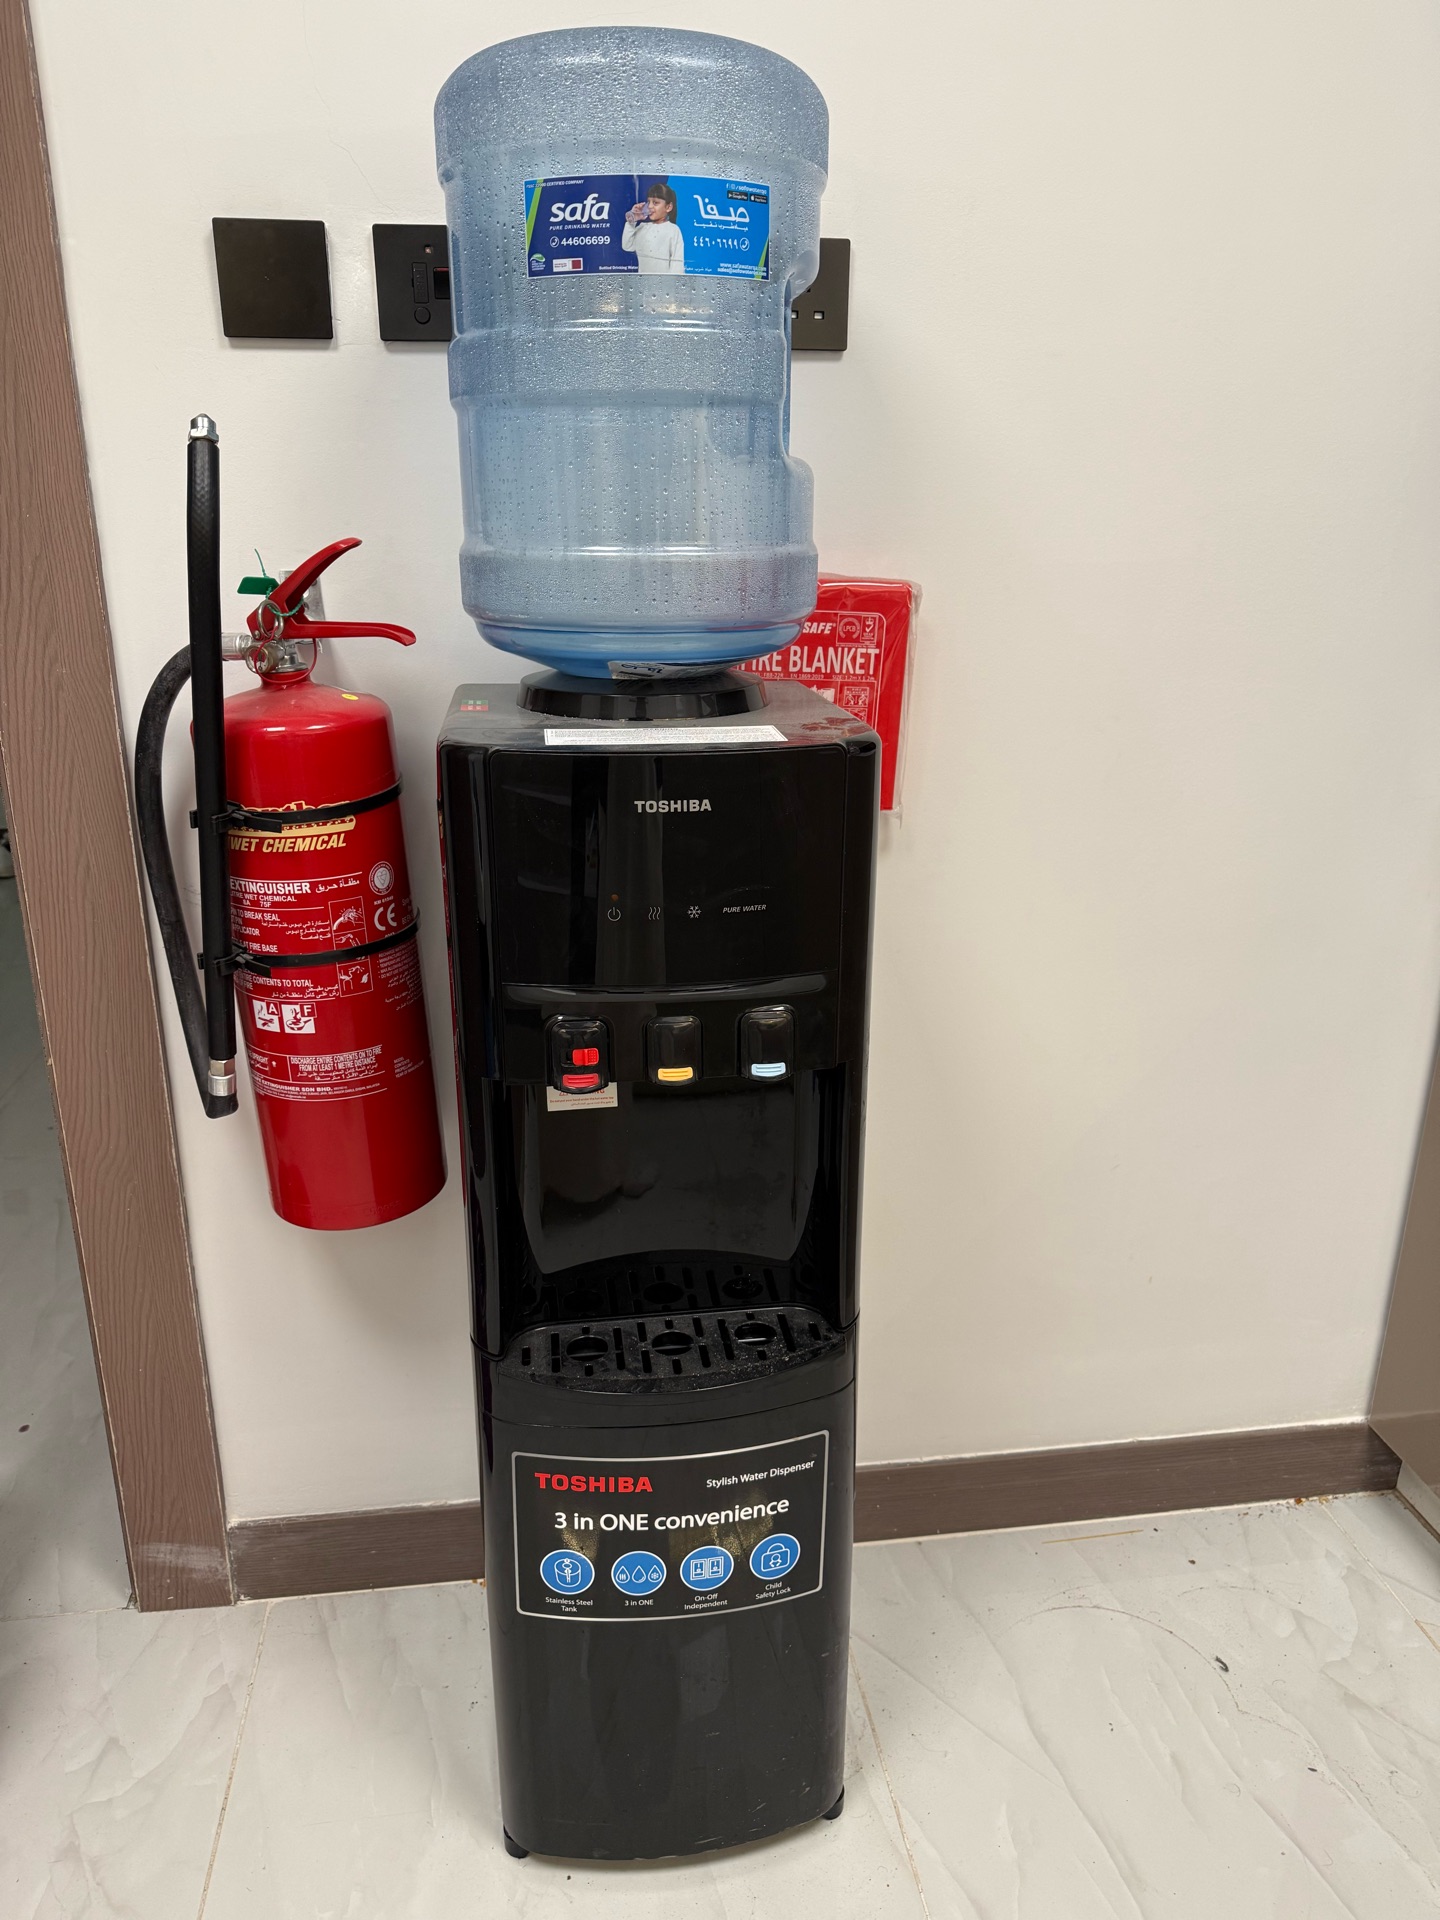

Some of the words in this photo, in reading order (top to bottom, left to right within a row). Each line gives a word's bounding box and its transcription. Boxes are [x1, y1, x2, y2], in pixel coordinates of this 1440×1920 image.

[550, 193, 610, 223] safa
[693, 194, 750, 223] صفا
[561, 236, 610, 246] 44606699
[789, 646, 880, 675] BLANKET
[634, 799, 712, 813] TOSHIBA
[230, 836, 259, 852] WET
[262, 834, 346, 853] CHEMICAL
[230, 879, 311, 894] EXTINGUISHER
[743, 904, 766, 912] WATER
[244, 911, 263, 920] BREAK
[263, 913, 280, 921] SEAL
[249, 942, 261, 951] FIRE
[261, 944, 279, 953] BASE
[253, 976, 282, 987] CONTENTS
[292, 979, 314, 987] TOTAL
[268, 1003, 278, 1014] A
[304, 1005, 312, 1016] F
[334, 1053, 358, 1063] CONTENTS
[372, 1047, 382, 1055] FIRE
[338, 1061, 354, 1070] METRE
[354, 1056, 376, 1067] DISTANCE
[706, 1476, 738, 1488] Stylish
[740, 1471, 768, 1483] Water
[770, 1460, 815, 1477] Dispenser
[534, 1472, 653, 1492] TOSHIBA
[555, 1512, 567, 1529] 3
[574, 1512, 594, 1530] in
[600, 1514, 649, 1531] ONE
[654, 1499, 789, 1530] convenience
[765, 1582, 782, 1590] Child
[694, 1593, 718, 1602] On-Off
[755, 1590, 776, 1600] Safety
[777, 1587, 791, 1595] Lock
[545, 1597, 575, 1605] Stainless
[684, 1600, 728, 1610] Independent
